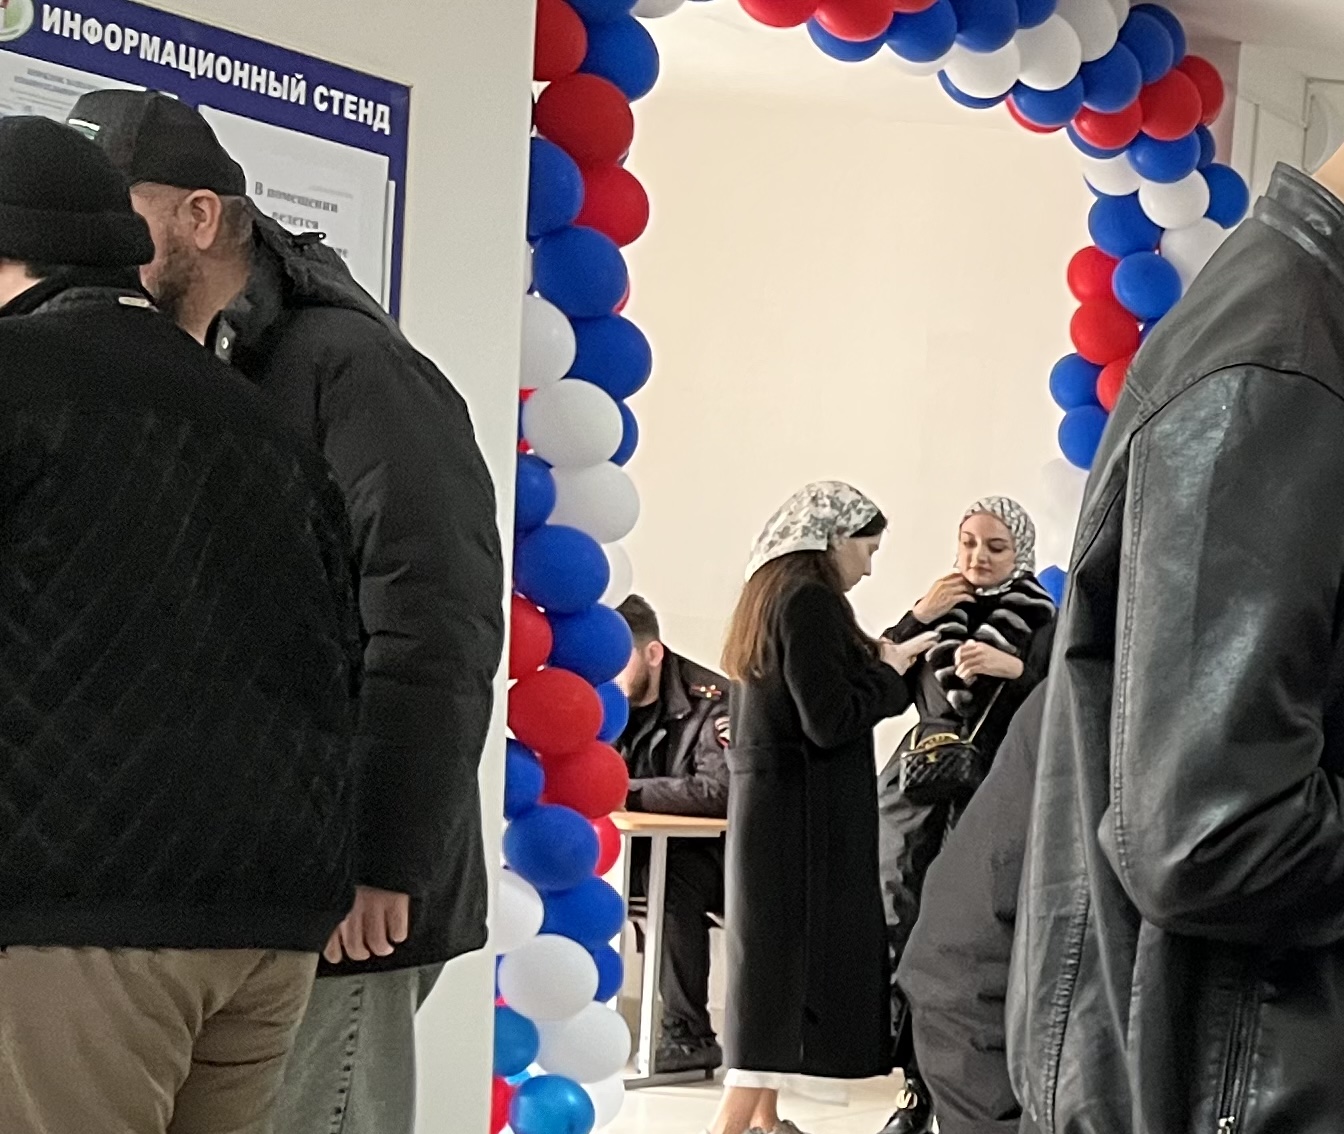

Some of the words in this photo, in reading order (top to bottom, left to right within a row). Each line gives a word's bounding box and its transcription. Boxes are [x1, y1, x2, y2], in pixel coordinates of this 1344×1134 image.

[42, 4, 306, 106] ИНФОРМАЦИОННЫЙ
[312, 85, 392, 136] СТЕНД
[255, 181, 263, 196] В
